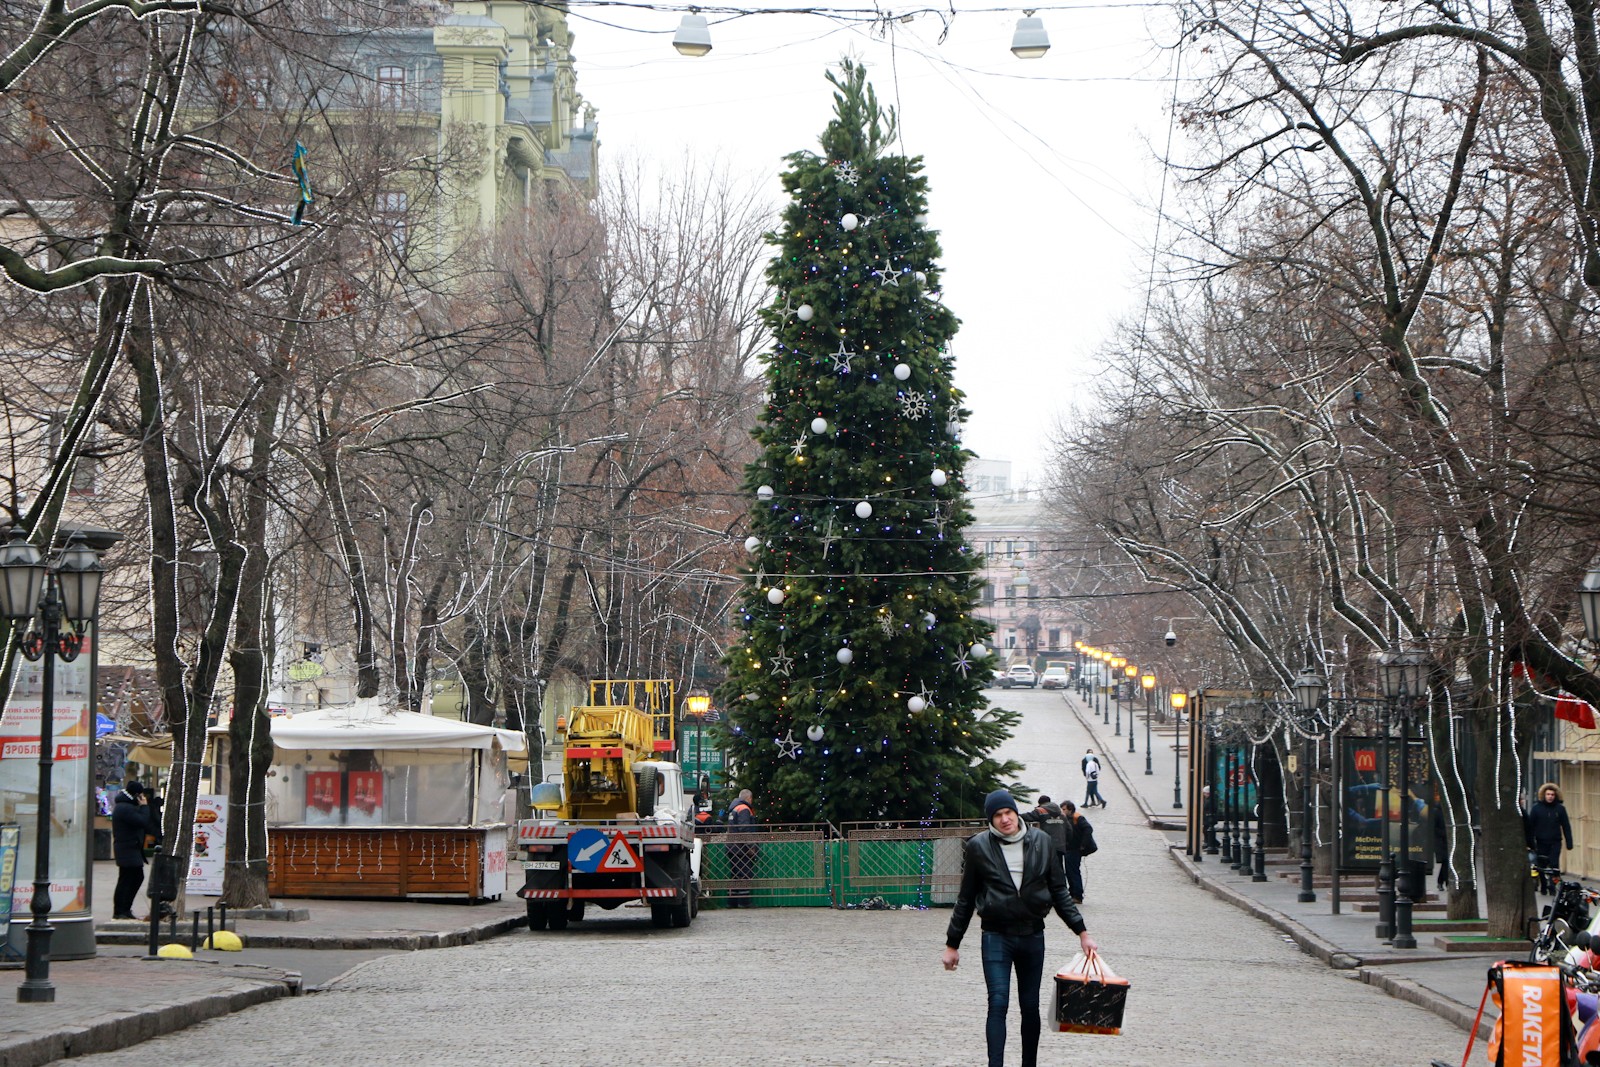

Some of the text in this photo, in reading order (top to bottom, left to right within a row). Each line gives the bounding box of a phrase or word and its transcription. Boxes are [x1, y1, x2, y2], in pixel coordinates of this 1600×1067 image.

[5, 744, 43, 755] ЗРОБЛЕ
[191, 867, 203, 876] 69
[1522, 985, 1543, 1067] RAKETA
